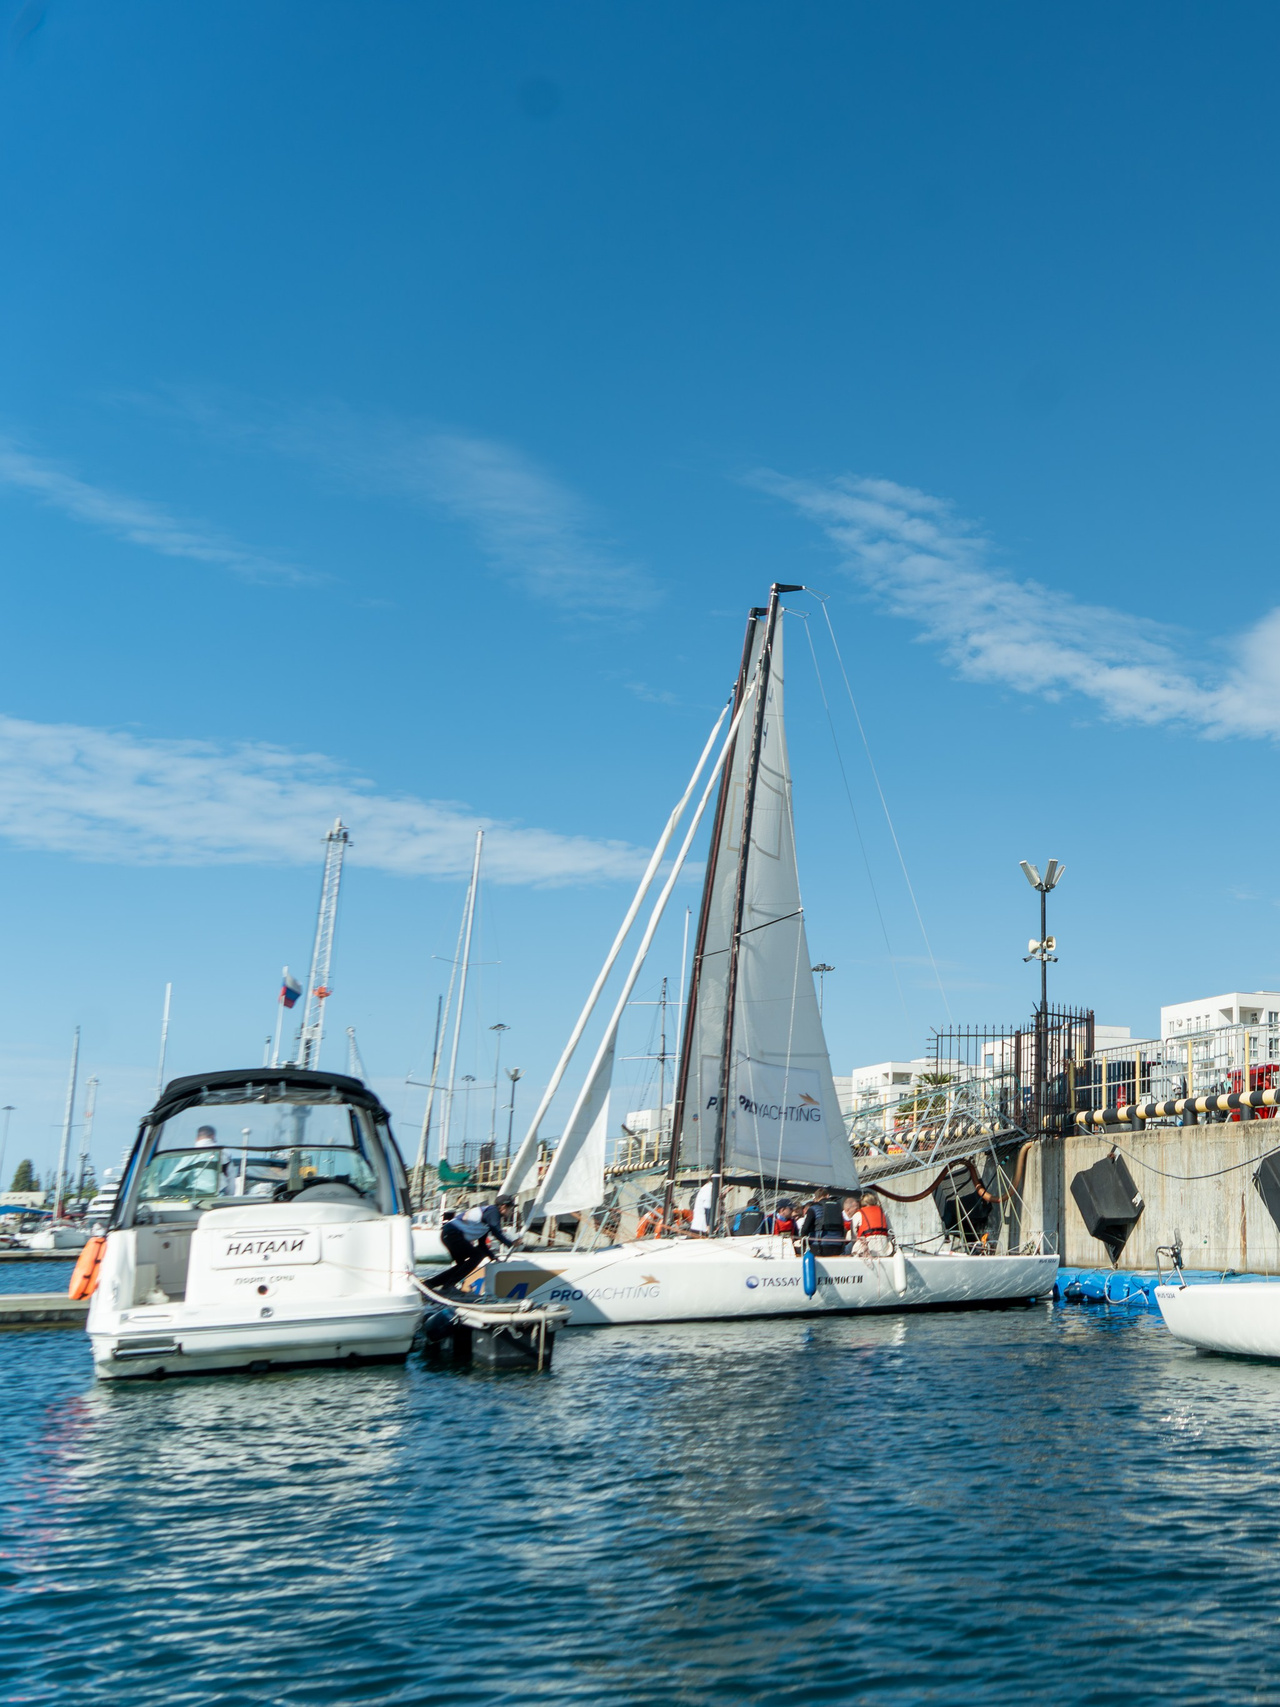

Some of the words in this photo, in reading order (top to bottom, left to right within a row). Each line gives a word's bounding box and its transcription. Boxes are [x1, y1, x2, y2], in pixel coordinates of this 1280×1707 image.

[226, 1239, 305, 1256] НАТАЛИ
[761, 1277, 801, 1287] TASSAY
[817, 1275, 863, 1286] ЕДОМОСТИ
[551, 1285, 661, 1301] PROYACHTING
